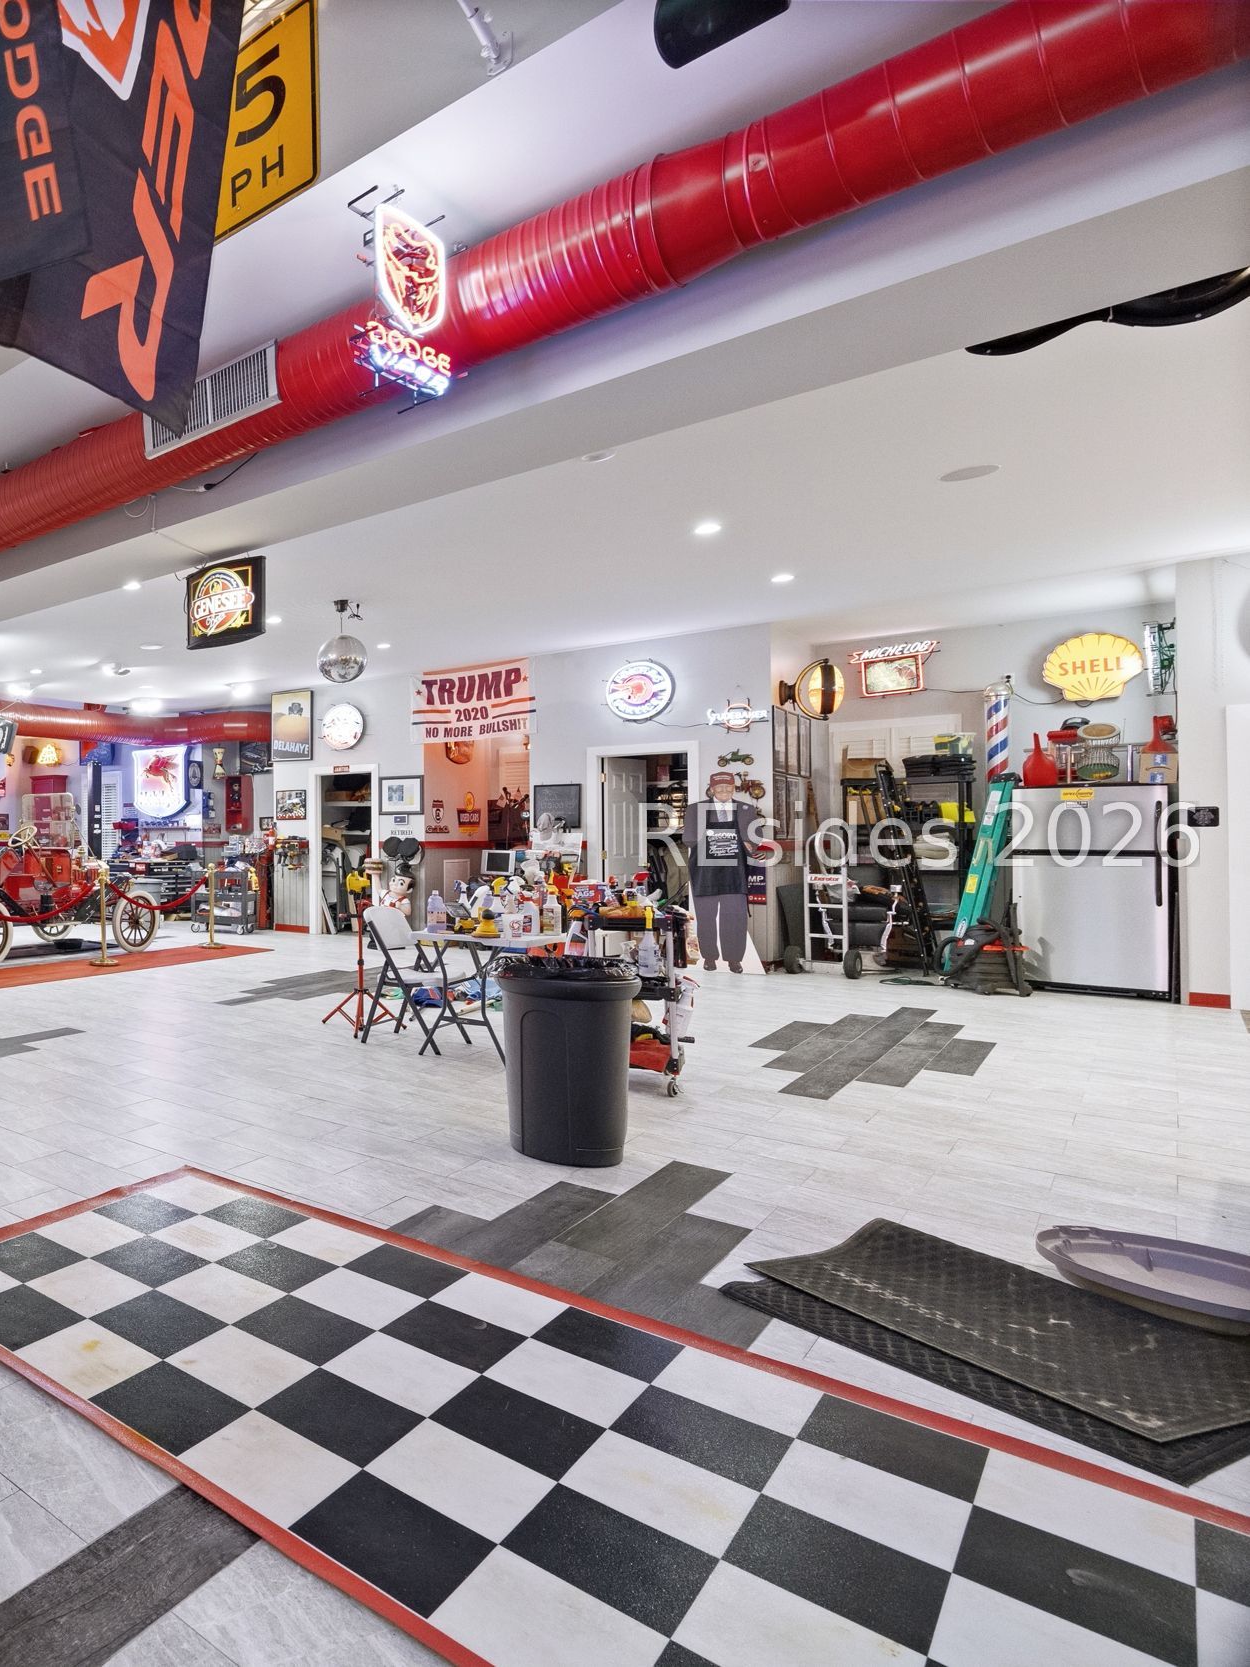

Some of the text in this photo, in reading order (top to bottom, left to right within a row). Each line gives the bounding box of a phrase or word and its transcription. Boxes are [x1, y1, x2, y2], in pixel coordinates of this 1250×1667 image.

[230, 144, 284, 208] PH
[365, 320, 452, 377] DODGE
[194, 589, 246, 619] GENESEE
[860, 640, 932, 660] MICHELOB
[1058, 656, 1127, 677] SHELL
[421, 667, 522, 706] TRUMP
[454, 706, 489, 723] 2020
[425, 717, 529, 739] NO MORE BULLSHIT
[273, 739, 310, 754] DELAHAYE
[809, 875, 840, 883] Liberator
[573, 890, 595, 898] RAGS
